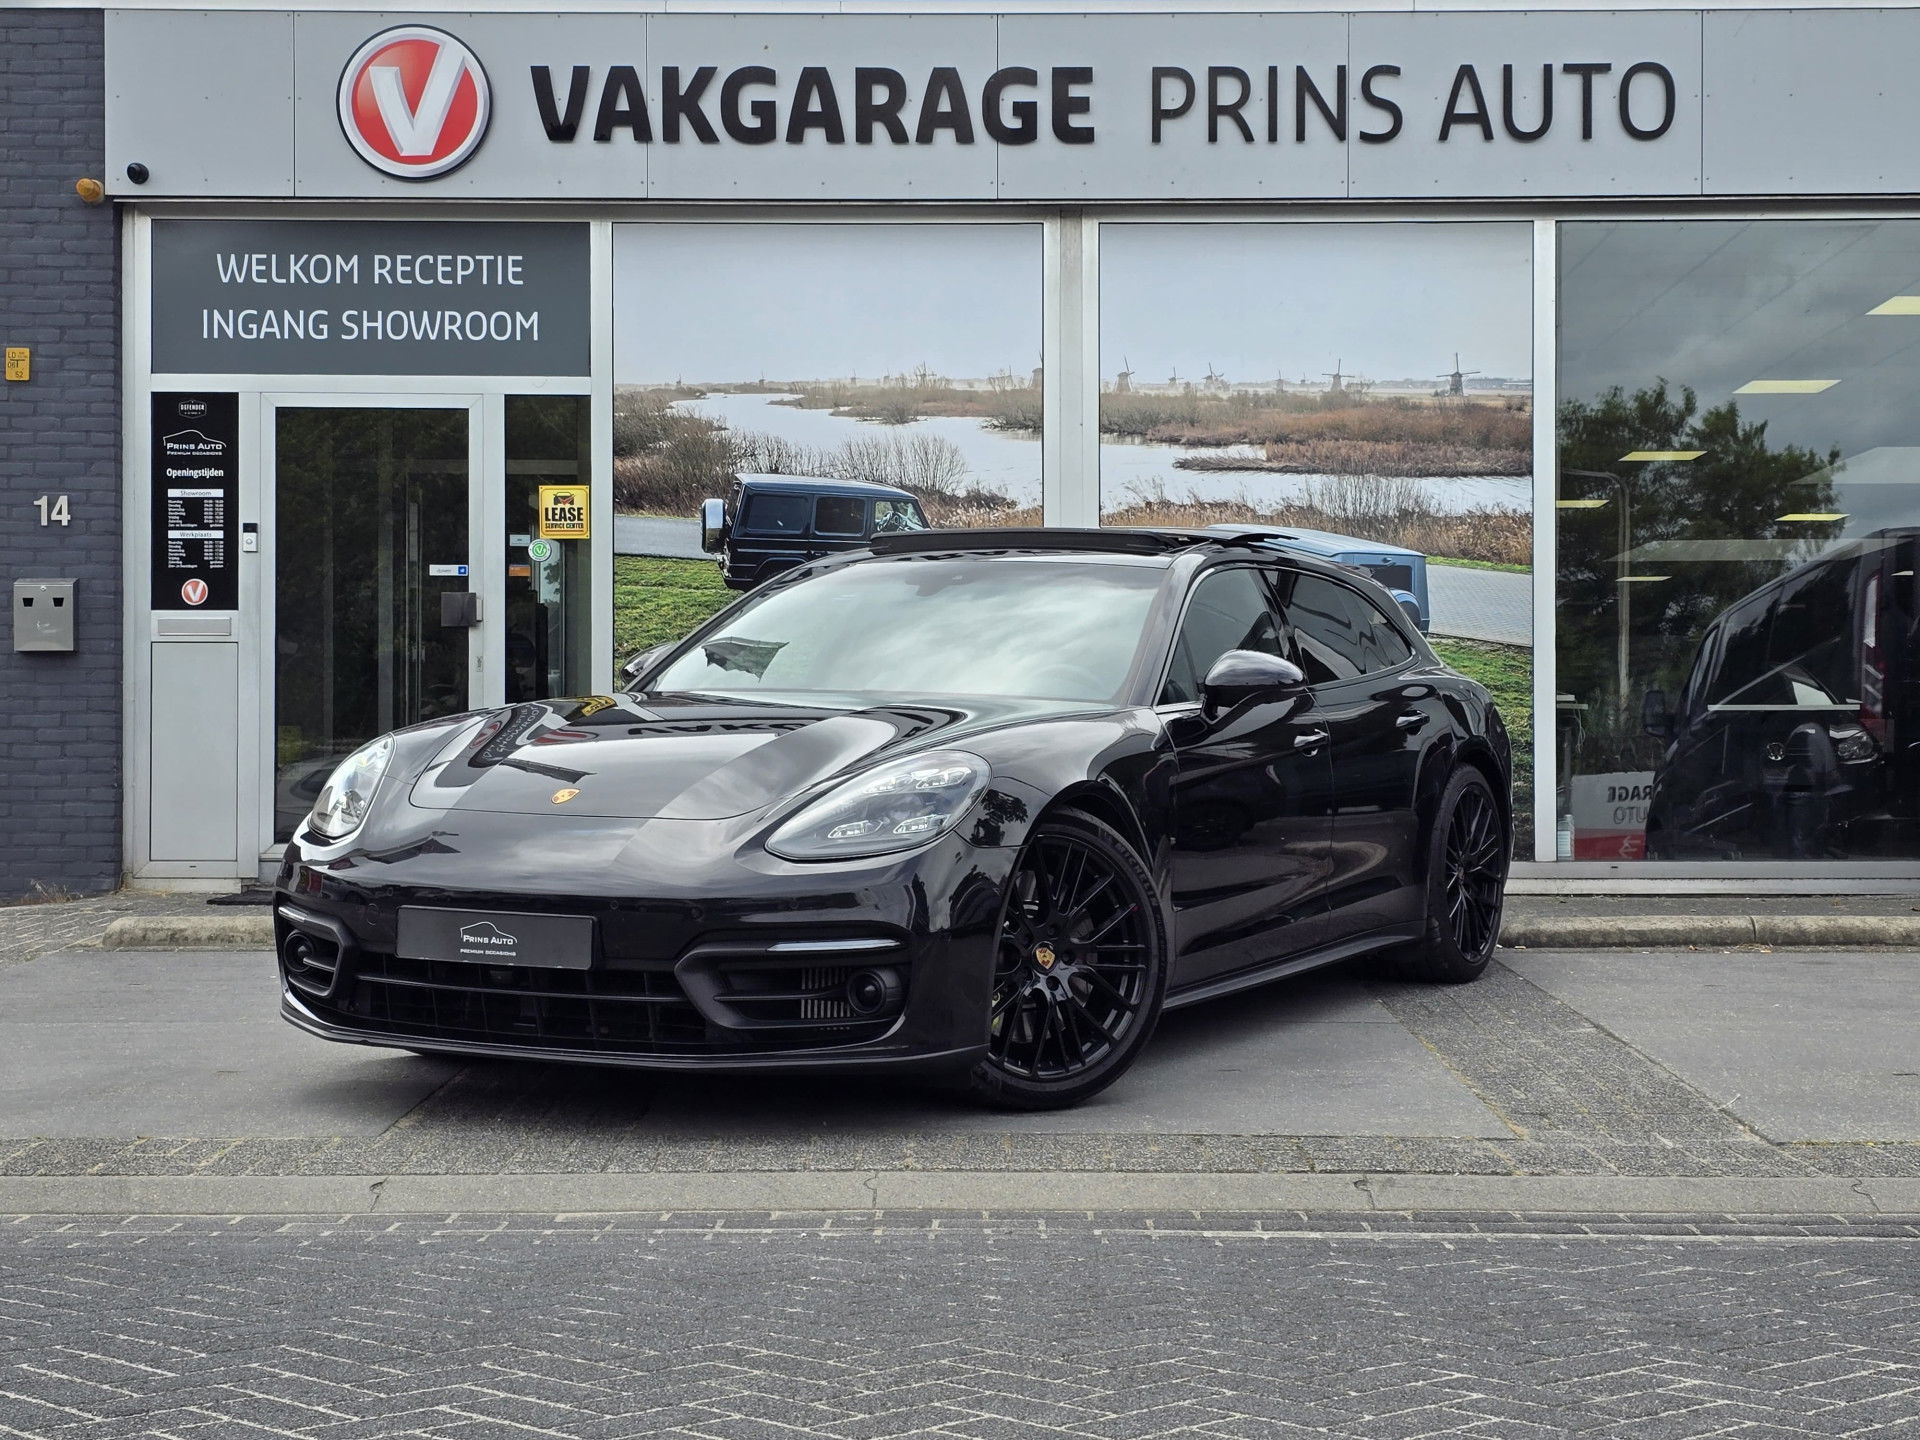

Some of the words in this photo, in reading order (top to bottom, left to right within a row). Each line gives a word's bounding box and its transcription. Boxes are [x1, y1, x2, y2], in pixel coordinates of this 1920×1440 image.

[531, 66, 1094, 146] VAKGARAGE
[1152, 64, 1403, 144] PRINS
[1438, 61, 1676, 143] AUTO
[216, 253, 359, 285] WELKOM
[374, 254, 524, 286] RECEPTIE
[202, 308, 329, 341] INGANG
[341, 309, 540, 342] SHOWROOM
[166, 442, 196, 450] PRINS
[197, 442, 223, 450] AUTO
[166, 467, 224, 479] Openingstijden
[34, 495, 71, 526] 14
[545, 507, 584, 522] LEASE
[463, 934, 489, 944] PRINS
[490, 936, 514, 945] AUTO
